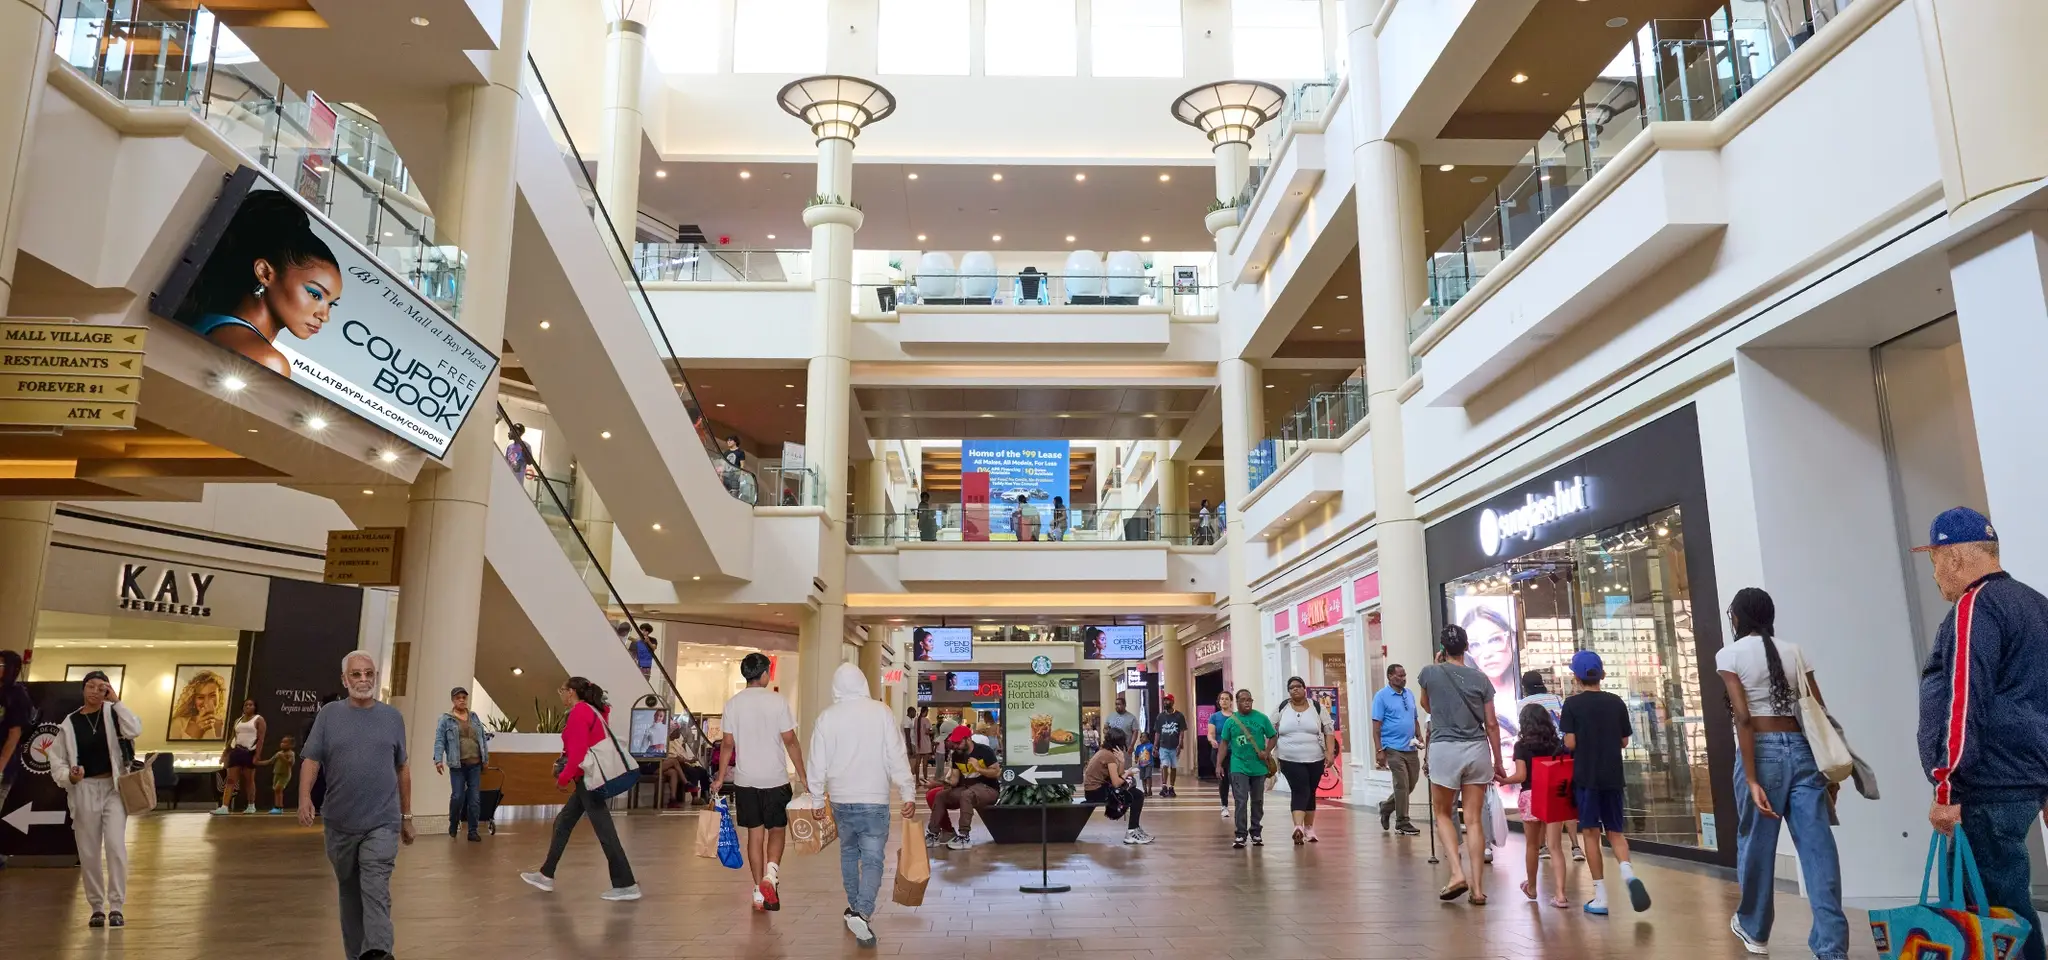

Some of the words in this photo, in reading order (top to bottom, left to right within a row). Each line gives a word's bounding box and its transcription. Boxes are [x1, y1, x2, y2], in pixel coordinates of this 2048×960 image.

[382, 286, 404, 308] The
[404, 305, 432, 329] Mall
[430, 325, 441, 338] at
[442, 334, 462, 353] Bay
[461, 347, 487, 371] Plaza
[5, 330, 46, 341] MALL
[50, 331, 113, 344] VILLAGE
[4, 355, 109, 369] RESTAURANTS
[342, 320, 470, 411] COUPON
[437, 359, 477, 392] FREE
[17, 381, 86, 394] FOREVER
[89, 385, 104, 394] 21
[293, 358, 444, 446] MALLATBAYPLAZA.COM/COUPONS
[372, 367, 461, 431] BOOK
[67, 408, 102, 419] ATM
[1006, 450, 1020, 458] the
[1022, 450, 1036, 458] $99
[1038, 451, 1062, 459] Lease
[1498, 489, 1556, 541] sunglass
[1554, 475, 1585, 518] hut
[121, 564, 215, 606] KAY
[119, 599, 211, 617] JEWELERS
[1007, 680, 1048, 689] Espresso
[276, 690, 293, 699] every
[294, 690, 317, 702] KISS
[1008, 689, 1050, 699] Horchata
[281, 703, 300, 715] begins
[302, 704, 315, 712] with
[1021, 701, 1035, 709] Ice
